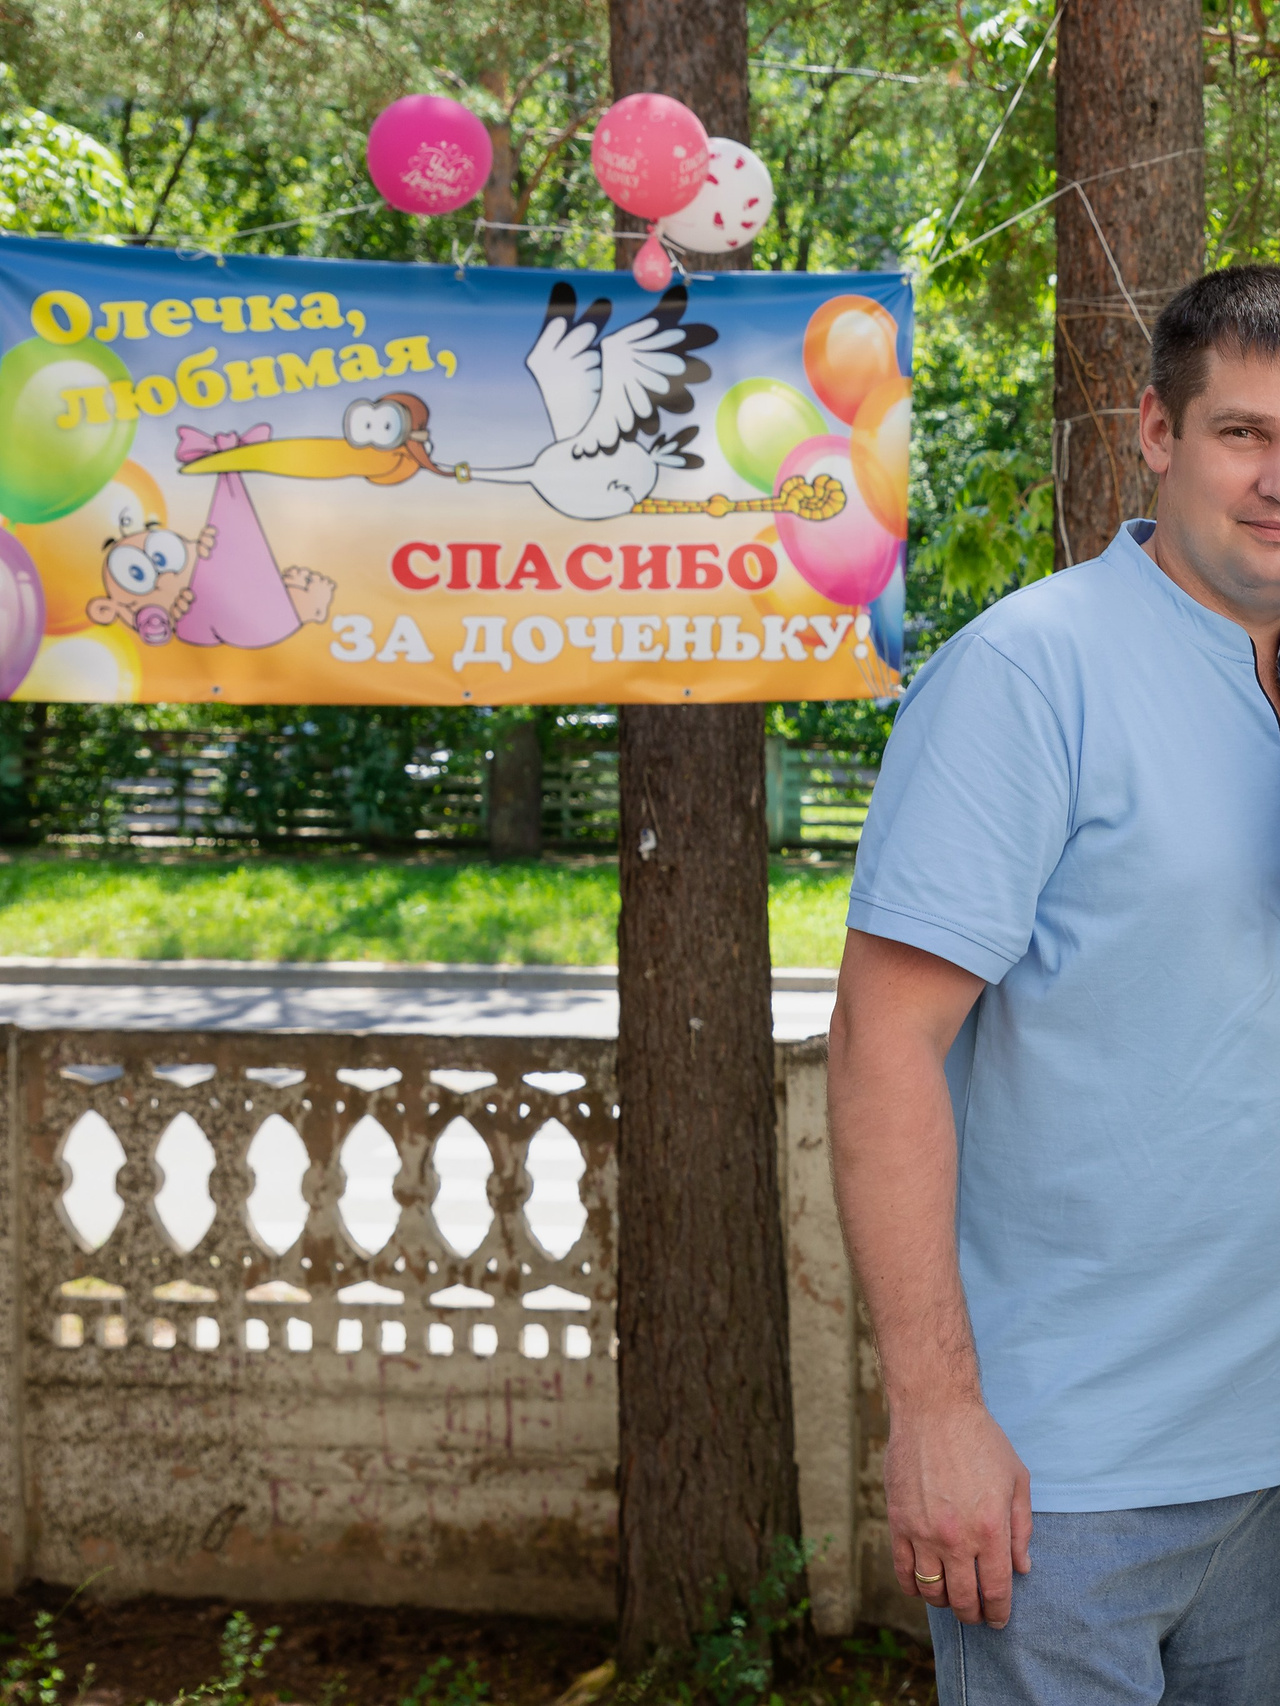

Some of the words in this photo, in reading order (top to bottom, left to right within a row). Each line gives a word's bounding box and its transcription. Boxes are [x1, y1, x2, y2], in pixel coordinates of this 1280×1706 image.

[30, 289, 367, 345] Олечка,
[56, 335, 458, 430] любимая,
[390, 541, 779, 592] СПАСИБО
[329, 614, 434, 663] ЗА
[452, 613, 872, 673] ДОЧЕНЬКУ!
